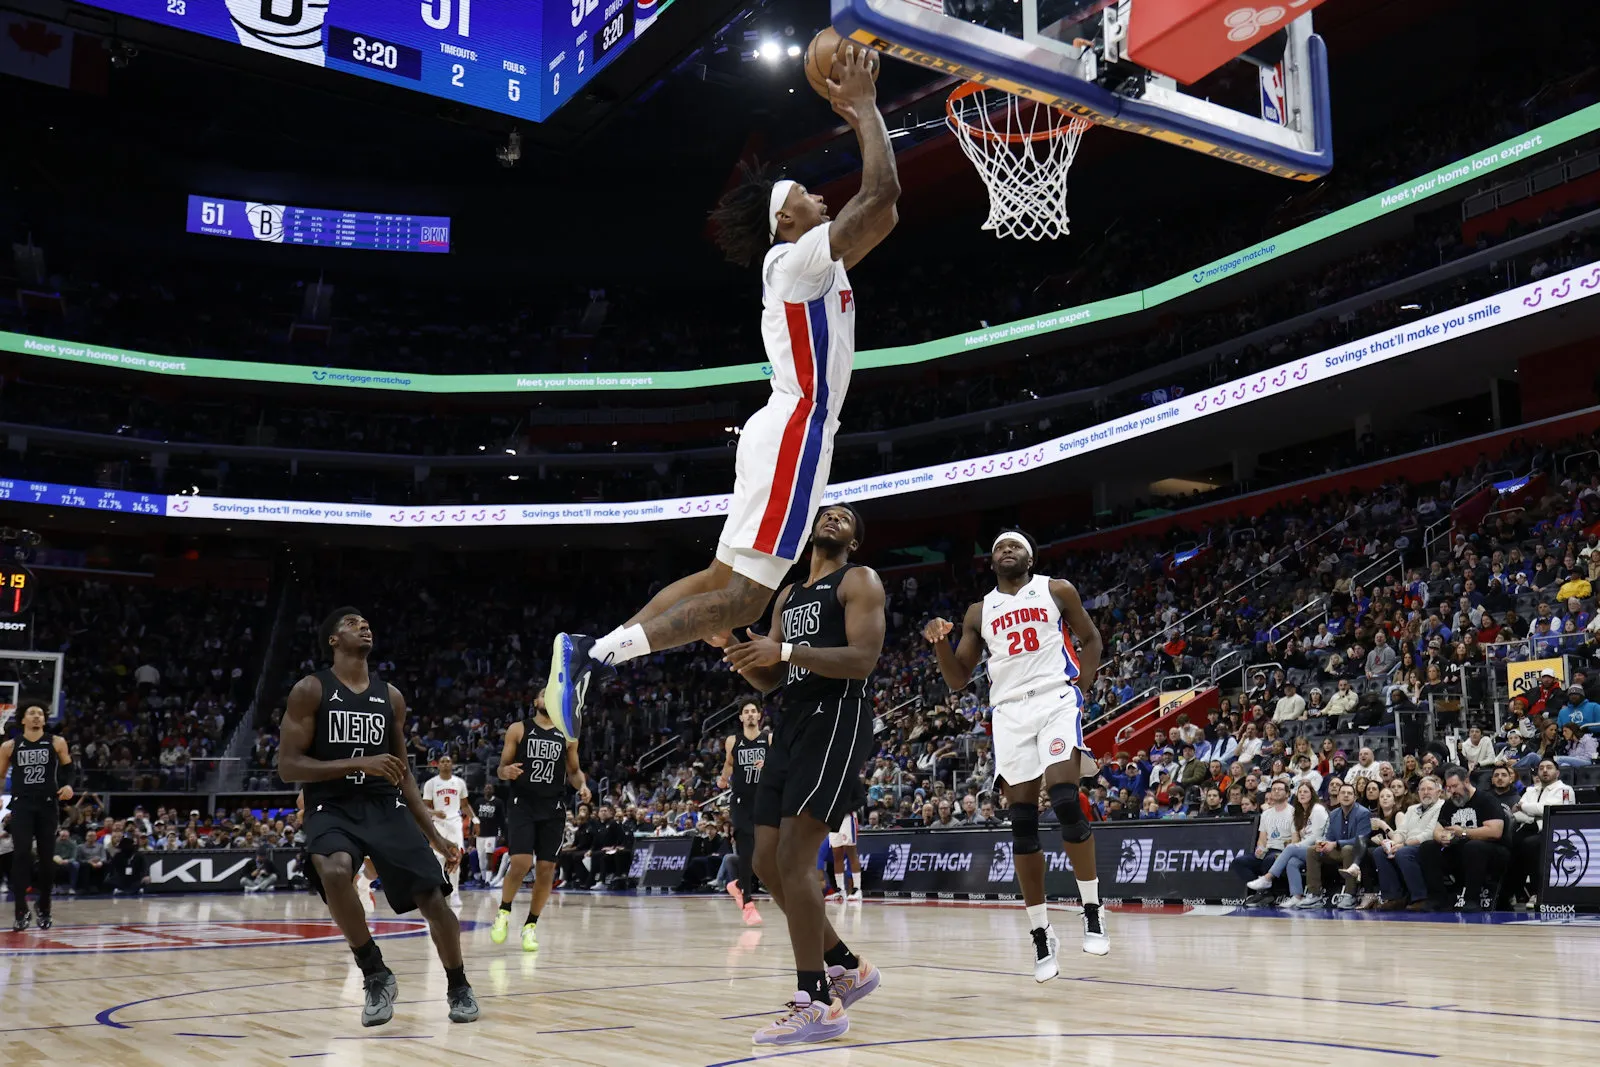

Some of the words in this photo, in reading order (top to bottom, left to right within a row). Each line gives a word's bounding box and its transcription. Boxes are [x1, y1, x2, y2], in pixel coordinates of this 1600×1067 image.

[167, 0, 186, 15] 23
[603, 13, 624, 50] 3:20
[352, 36, 398, 69] 3:20
[439, 42, 478, 62] TIMEOUTS:
[578, 49, 585, 74] 2
[451, 64, 464, 87] 2
[503, 60, 527, 75] FOULS:
[508, 79, 520, 102] 5
[1381, 191, 1409, 208] Meet
[1410, 178, 1436, 198] your
[1438, 165, 1470, 185] home
[1472, 154, 1498, 171] loan
[1501, 134, 1542, 159] expert
[201, 202, 224, 226] 51
[260, 211, 272, 235] B
[421, 226, 448, 243] BKN
[1206, 258, 1241, 277] mortgage
[1242, 244, 1275, 262] matchup
[965, 334, 988, 345] Meet
[989, 330, 1008, 342] your
[1010, 324, 1035, 335] home
[1037, 318, 1057, 329] loan
[1059, 310, 1090, 324] expert
[1325, 348, 1367, 367] Savings
[1370, 333, 1404, 353] that'll
[1407, 325, 1440, 342] make
[1442, 316, 1465, 333] you
[1468, 304, 1501, 322] smile
[24, 339, 56, 352] Meet
[58, 345, 85, 356] your
[86, 348, 118, 361] home
[121, 354, 146, 365] loan
[148, 359, 186, 371] expert
[329, 373, 371, 383] mortgage
[373, 376, 411, 386] matchup
[517, 378, 542, 387] Meet
[544, 378, 565, 388] your
[568, 377, 594, 386] home
[597, 377, 618, 385] loan
[619, 377, 653, 387] expert
[1059, 435, 1088, 452] Savings
[1090, 428, 1114, 442] that'll
[1115, 421, 1138, 434] make
[1140, 415, 1155, 429] you
[1157, 408, 1179, 421] smile
[30, 484, 47, 492] OREB
[823, 490, 842, 500] ings
[844, 483, 868, 496] that'll
[870, 480, 892, 492] make
[895, 478, 909, 488] you
[911, 473, 934, 484] smile
[0, 489, 10, 498] 23
[35, 493, 41, 501] 7
[61, 495, 85, 506] 72.7%
[98, 499, 122, 510] 22.7%
[132, 502, 159, 513] 34.5%
[212, 503, 255, 515] Savings
[258, 505, 289, 514] that'll
[292, 507, 321, 516] make
[324, 509, 343, 518] you
[346, 510, 372, 519] smile
[522, 509, 559, 520] Savings
[562, 508, 591, 517] that'll
[594, 508, 620, 517] make
[622, 508, 639, 518] you
[641, 506, 664, 514] smile
[0, 572, 25, 588] :19
[0, 622, 26, 631] SSOT
[781, 601, 821, 642] NETS
[991, 607, 1048, 635] PISTONS
[1007, 627, 1039, 656] 28
[1524, 671, 1542, 679] BET
[329, 710, 385, 745] NETS
[18, 750, 49, 766] NETS
[527, 739, 562, 761] NETS
[738, 748, 766, 765] NETS
[24, 766, 45, 784] 22
[530, 761, 555, 783] 24
[744, 765, 761, 784] 77
[444, 797, 450, 805] 9
[909, 852, 972, 871] BETMGM
[1153, 849, 1245, 872] BETMGM
[1540, 904, 1575, 913] StockX
